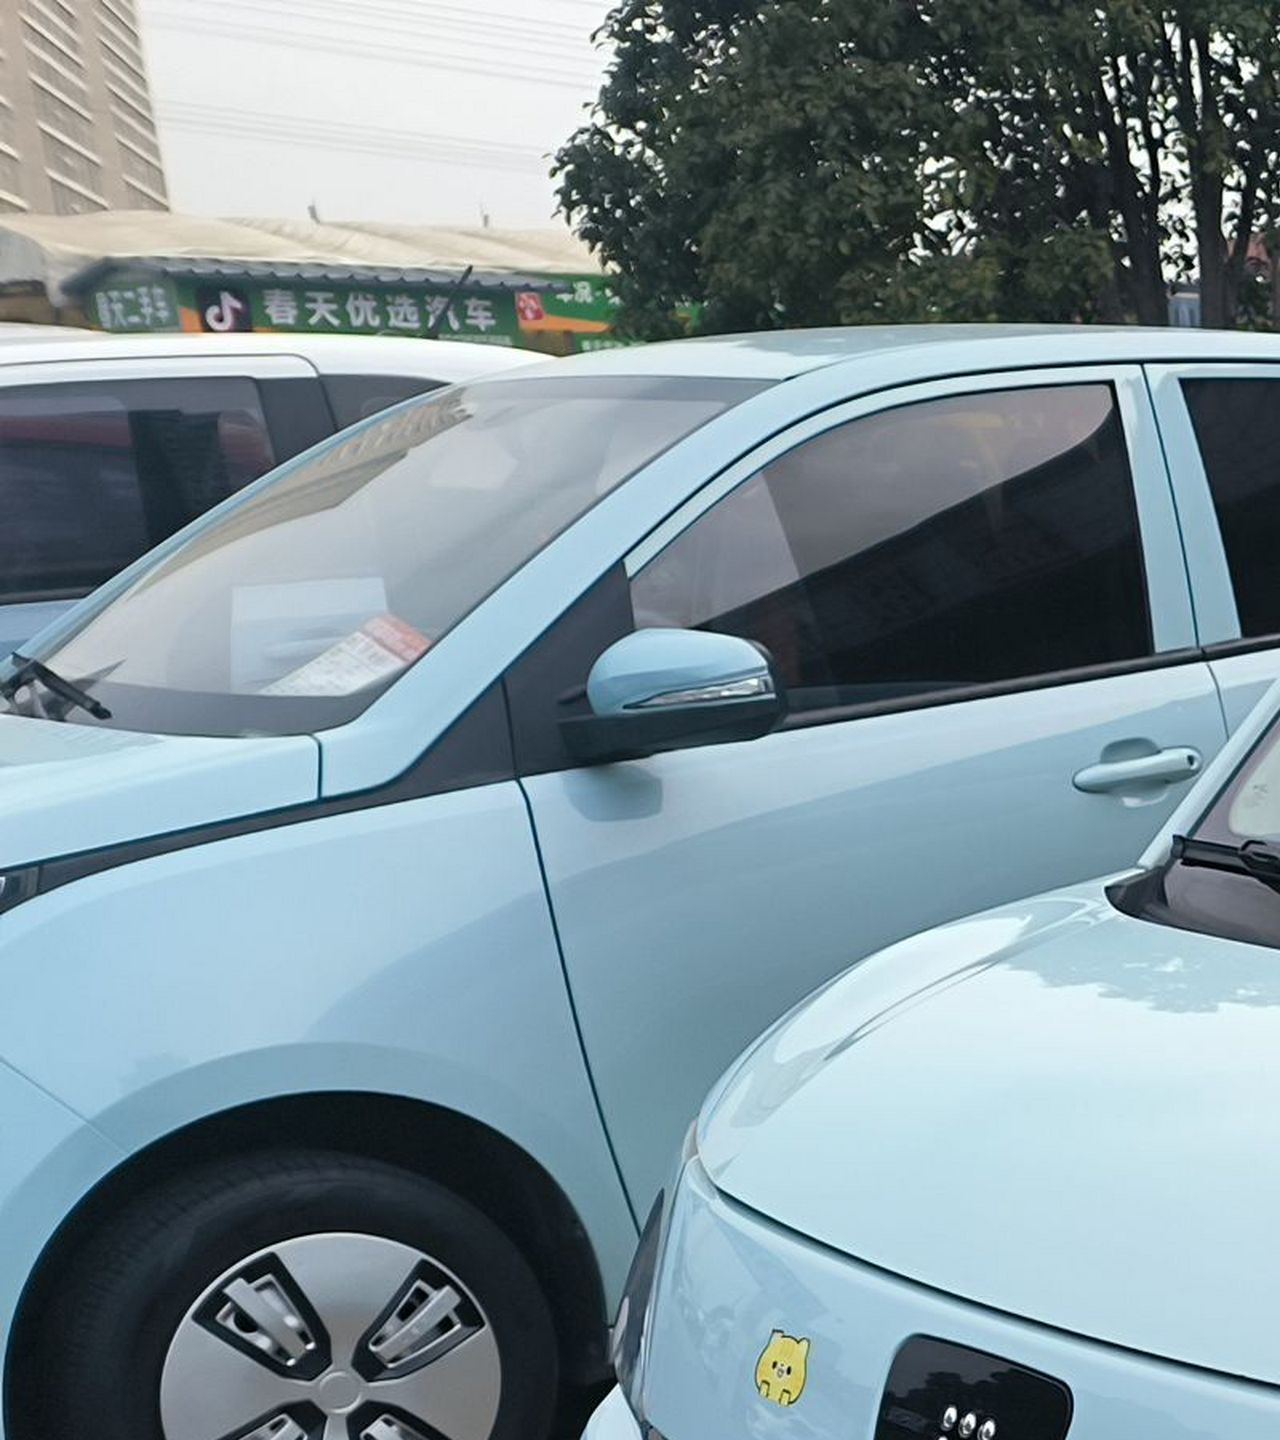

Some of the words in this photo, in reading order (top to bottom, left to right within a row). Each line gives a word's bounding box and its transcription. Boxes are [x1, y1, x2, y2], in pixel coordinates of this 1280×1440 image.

[264, 288, 497, 332] 春天优选汽车
